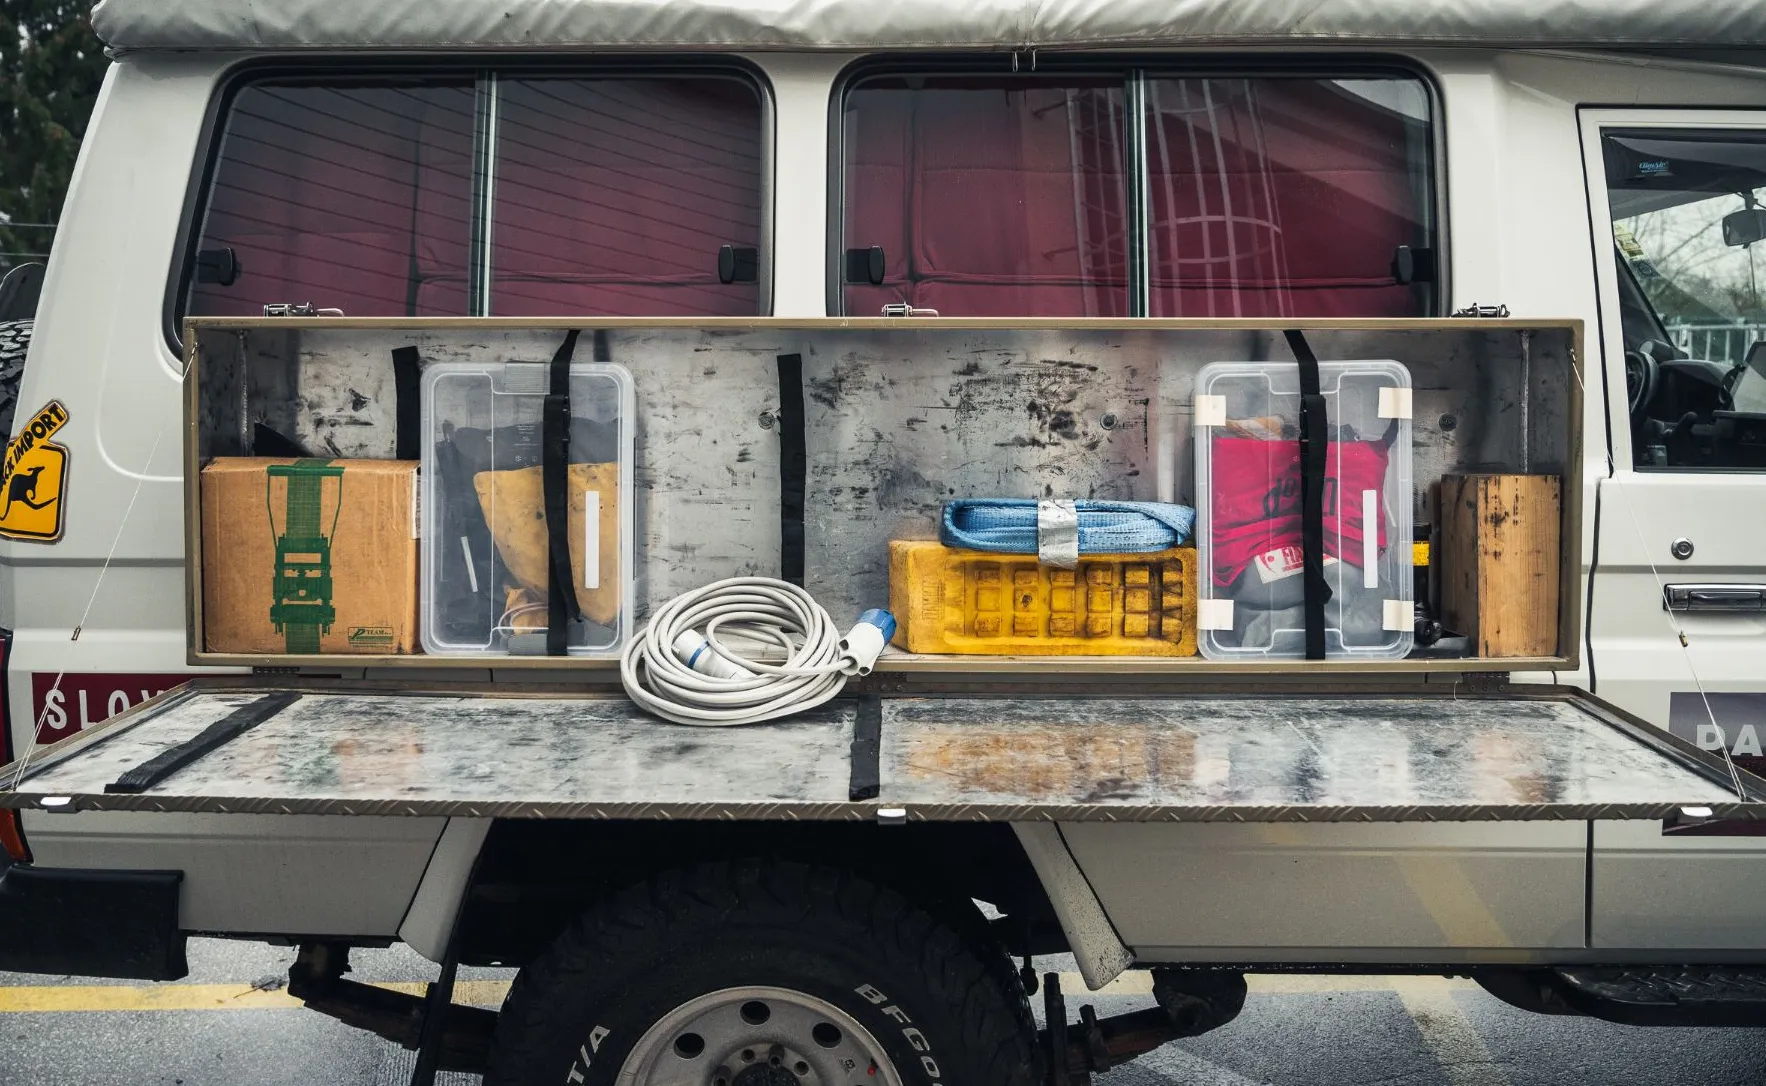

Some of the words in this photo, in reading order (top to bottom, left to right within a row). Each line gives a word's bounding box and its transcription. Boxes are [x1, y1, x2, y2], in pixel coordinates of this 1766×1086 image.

[13, 403, 64, 464] IMPORT
[45, 689, 165, 730] SLO
[566, 1023, 611, 1084] T/A
[854, 983, 943, 1086] BFGO
